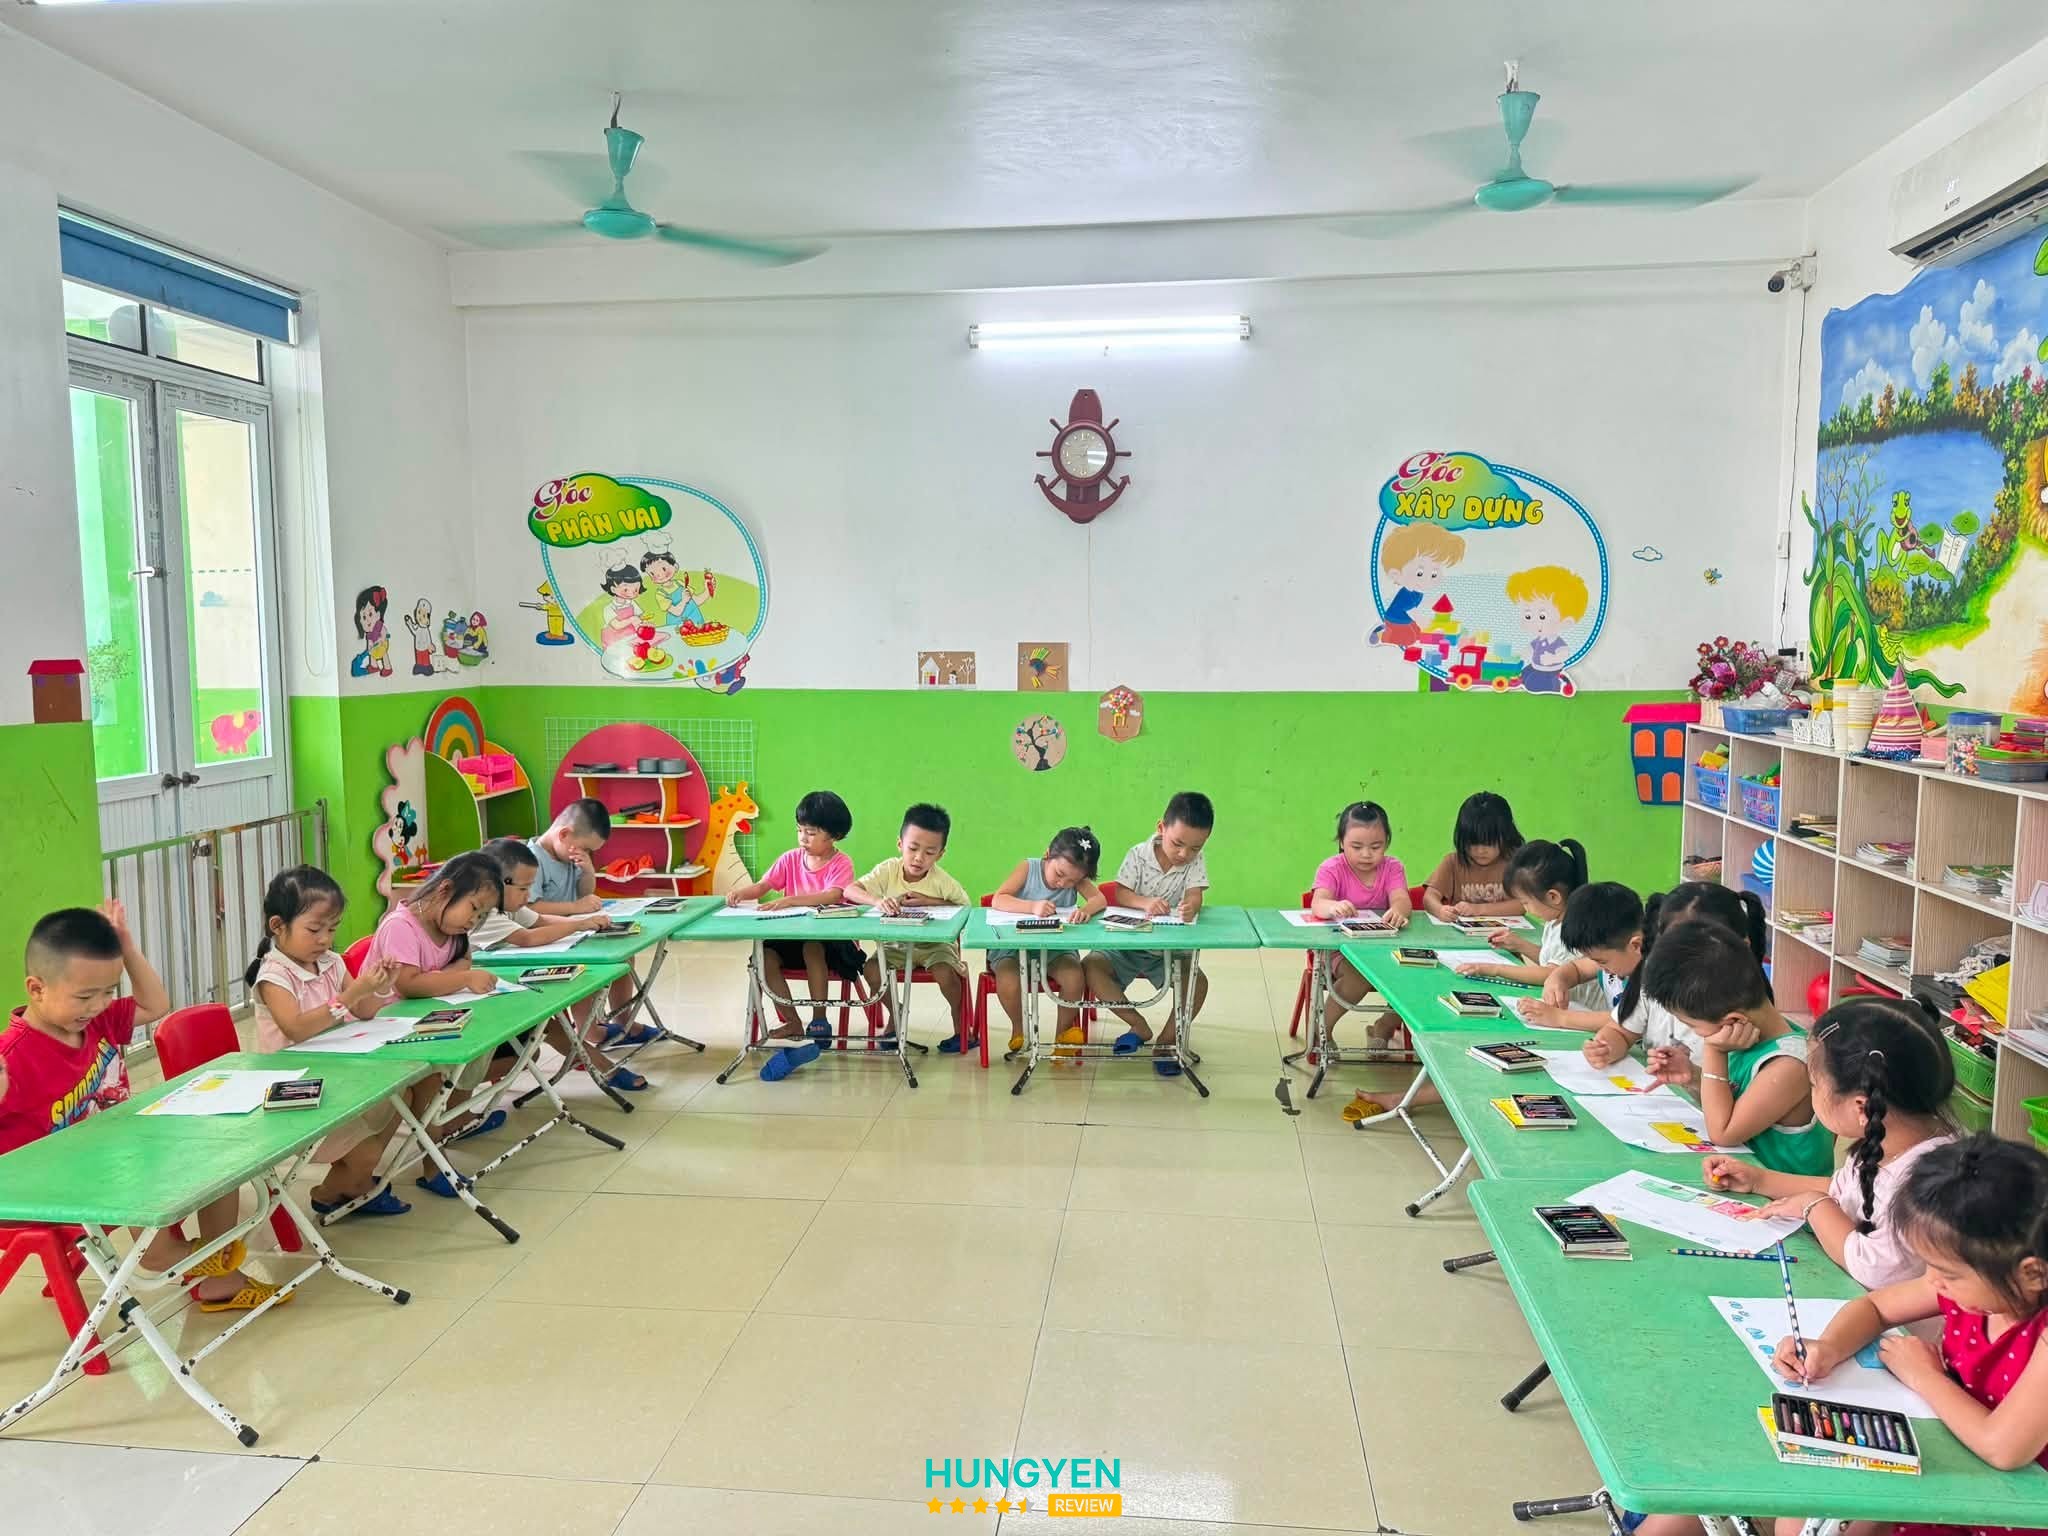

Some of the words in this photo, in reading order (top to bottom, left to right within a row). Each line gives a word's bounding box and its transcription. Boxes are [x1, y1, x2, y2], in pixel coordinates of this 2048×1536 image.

[1392, 452, 1463, 491] Góc
[534, 479, 591, 520] Góc
[1395, 488, 1455, 519] XÂY
[1463, 495, 1543, 526] DỰNG
[546, 511, 613, 542] PHÂN
[618, 506, 661, 531] VAI
